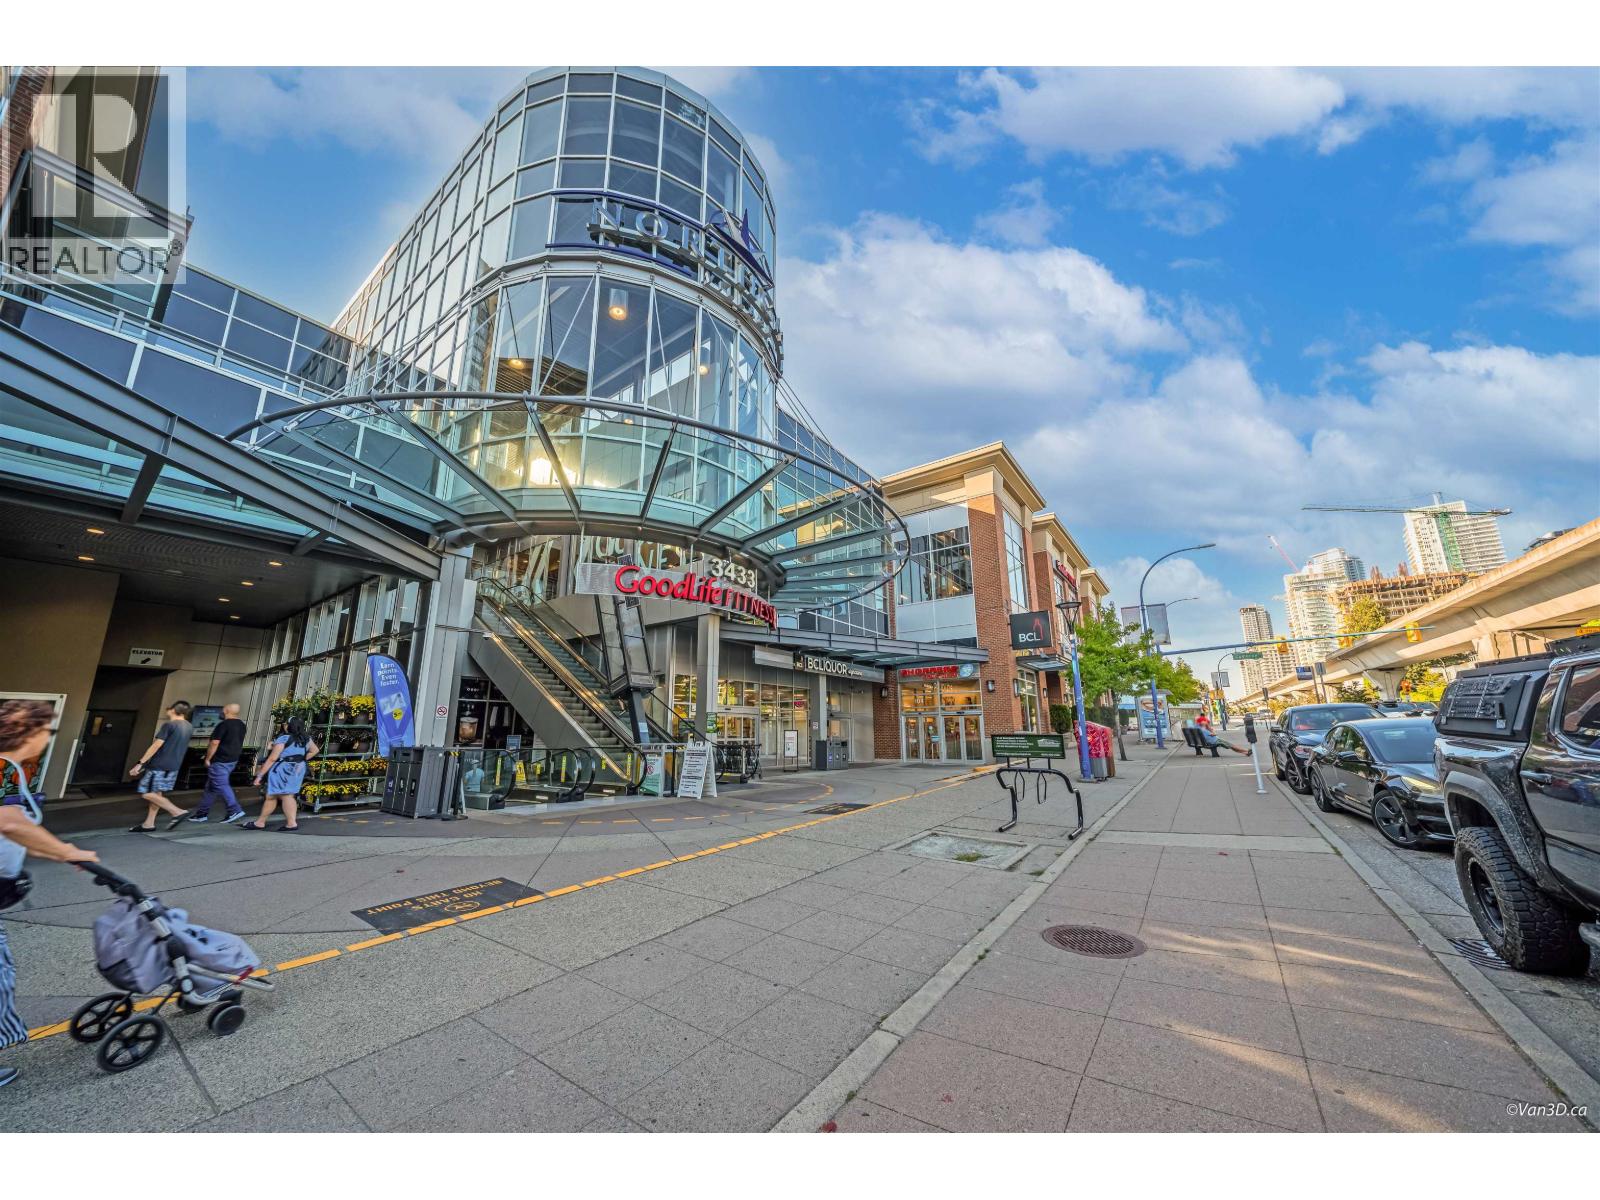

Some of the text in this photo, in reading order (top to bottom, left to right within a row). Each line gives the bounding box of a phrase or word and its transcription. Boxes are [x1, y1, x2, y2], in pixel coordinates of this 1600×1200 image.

[710, 558, 756, 588] 3433
[614, 564, 777, 631] GoodLife FITNESS
[1018, 632, 1041, 643] BCL
[377, 668, 400, 676] points.
[367, 879, 503, 915] BEYOND THIS POINT
[411, 895, 461, 911] CARTS
